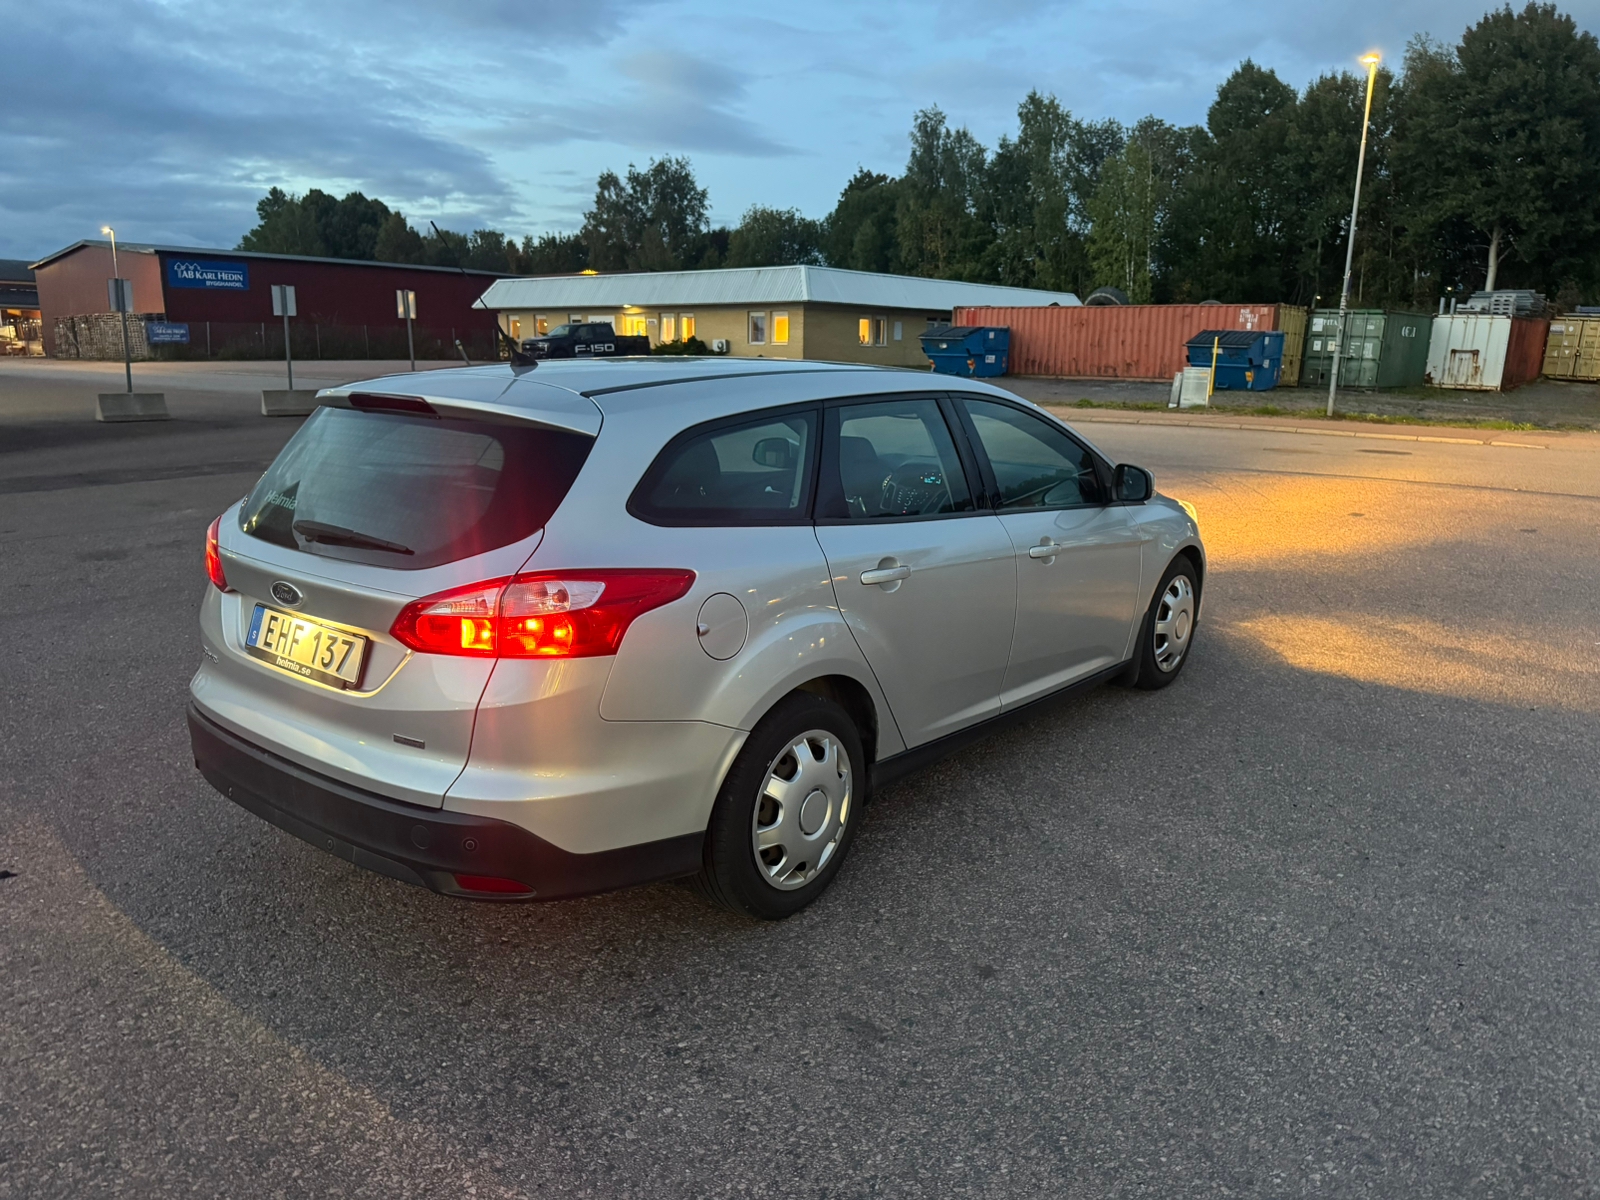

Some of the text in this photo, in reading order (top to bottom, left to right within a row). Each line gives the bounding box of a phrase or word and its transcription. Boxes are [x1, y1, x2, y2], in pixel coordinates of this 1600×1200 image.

[195, 271, 217, 280] KARL
[217, 271, 243, 281] HEDIN
[575, 343, 614, 353] F-150
[264, 489, 298, 510] Helmia
[275, 584, 294, 601] Ford
[251, 630, 257, 639] S
[263, 614, 304, 657] EHF
[311, 631, 356, 673] 137
[276, 655, 311, 676] helmia.se
